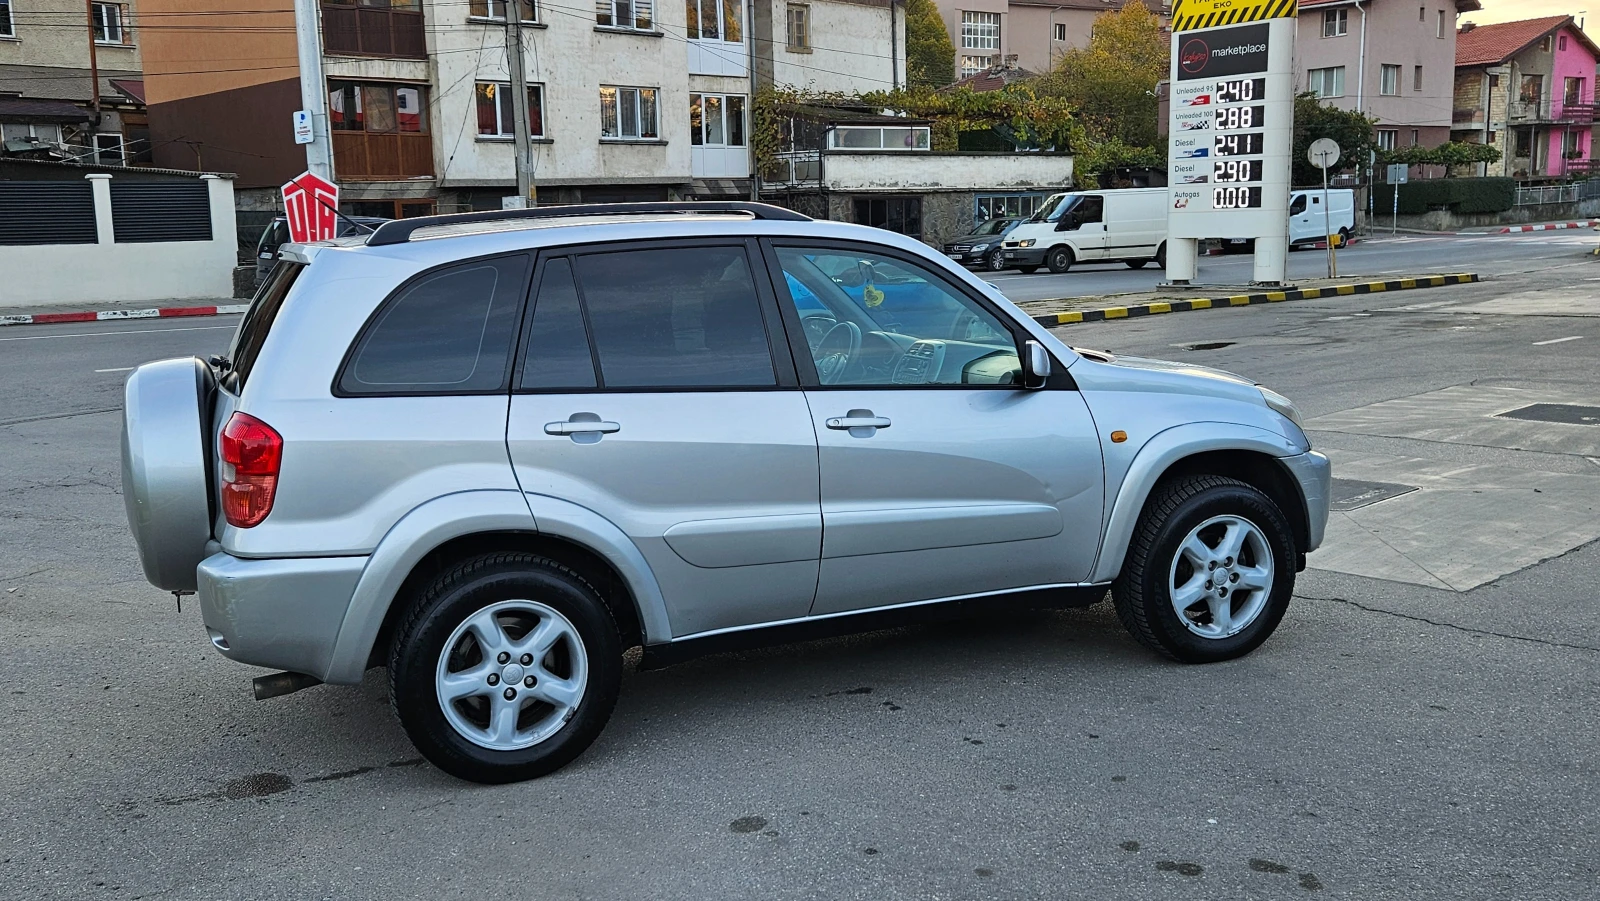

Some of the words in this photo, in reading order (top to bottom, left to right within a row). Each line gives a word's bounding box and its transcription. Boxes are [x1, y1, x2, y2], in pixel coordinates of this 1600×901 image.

[1212, 43, 1266, 57] marketplace
[1176, 86, 1204, 95] Unleaded
[1175, 111, 1202, 120] Unleaded
[1215, 106, 1252, 130] 2.88
[1175, 138, 1196, 146] Diesel
[1214, 134, 1251, 156] 2.41
[1174, 164, 1195, 172] Diesel
[1214, 160, 1250, 182] 2.90
[1213, 187, 1249, 208] 0.00
